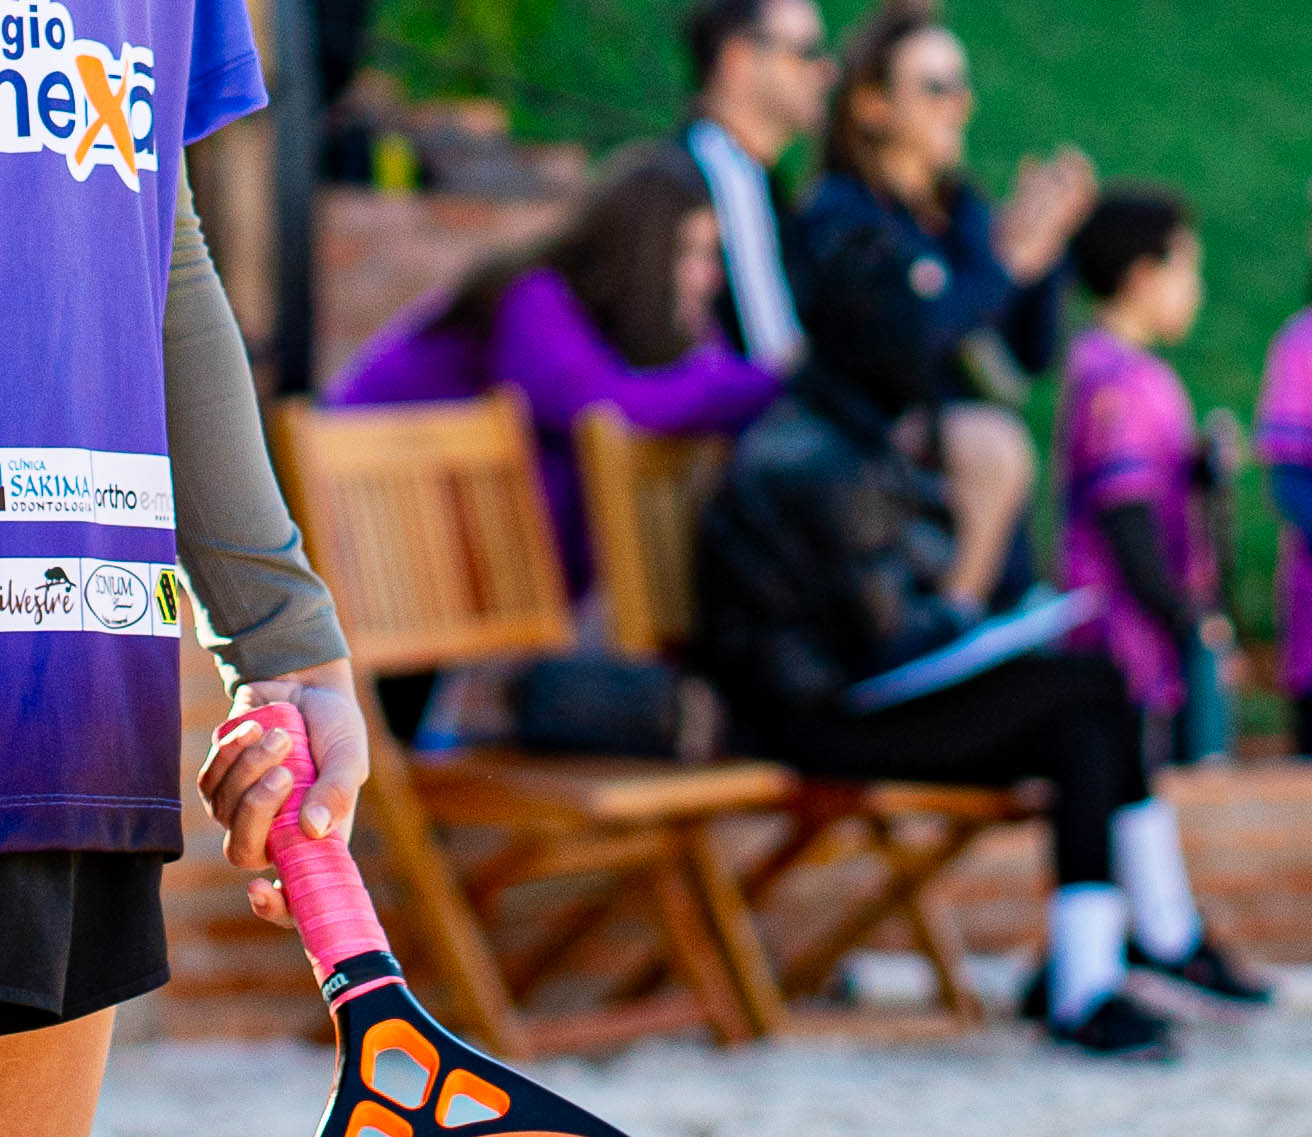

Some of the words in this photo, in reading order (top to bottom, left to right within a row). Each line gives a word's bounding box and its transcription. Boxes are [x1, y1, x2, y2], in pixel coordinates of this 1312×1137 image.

[8, 458, 46, 471] CLÍNICA
[10, 474, 90, 498] SAKIMA
[95, 483, 137, 510] ortho
